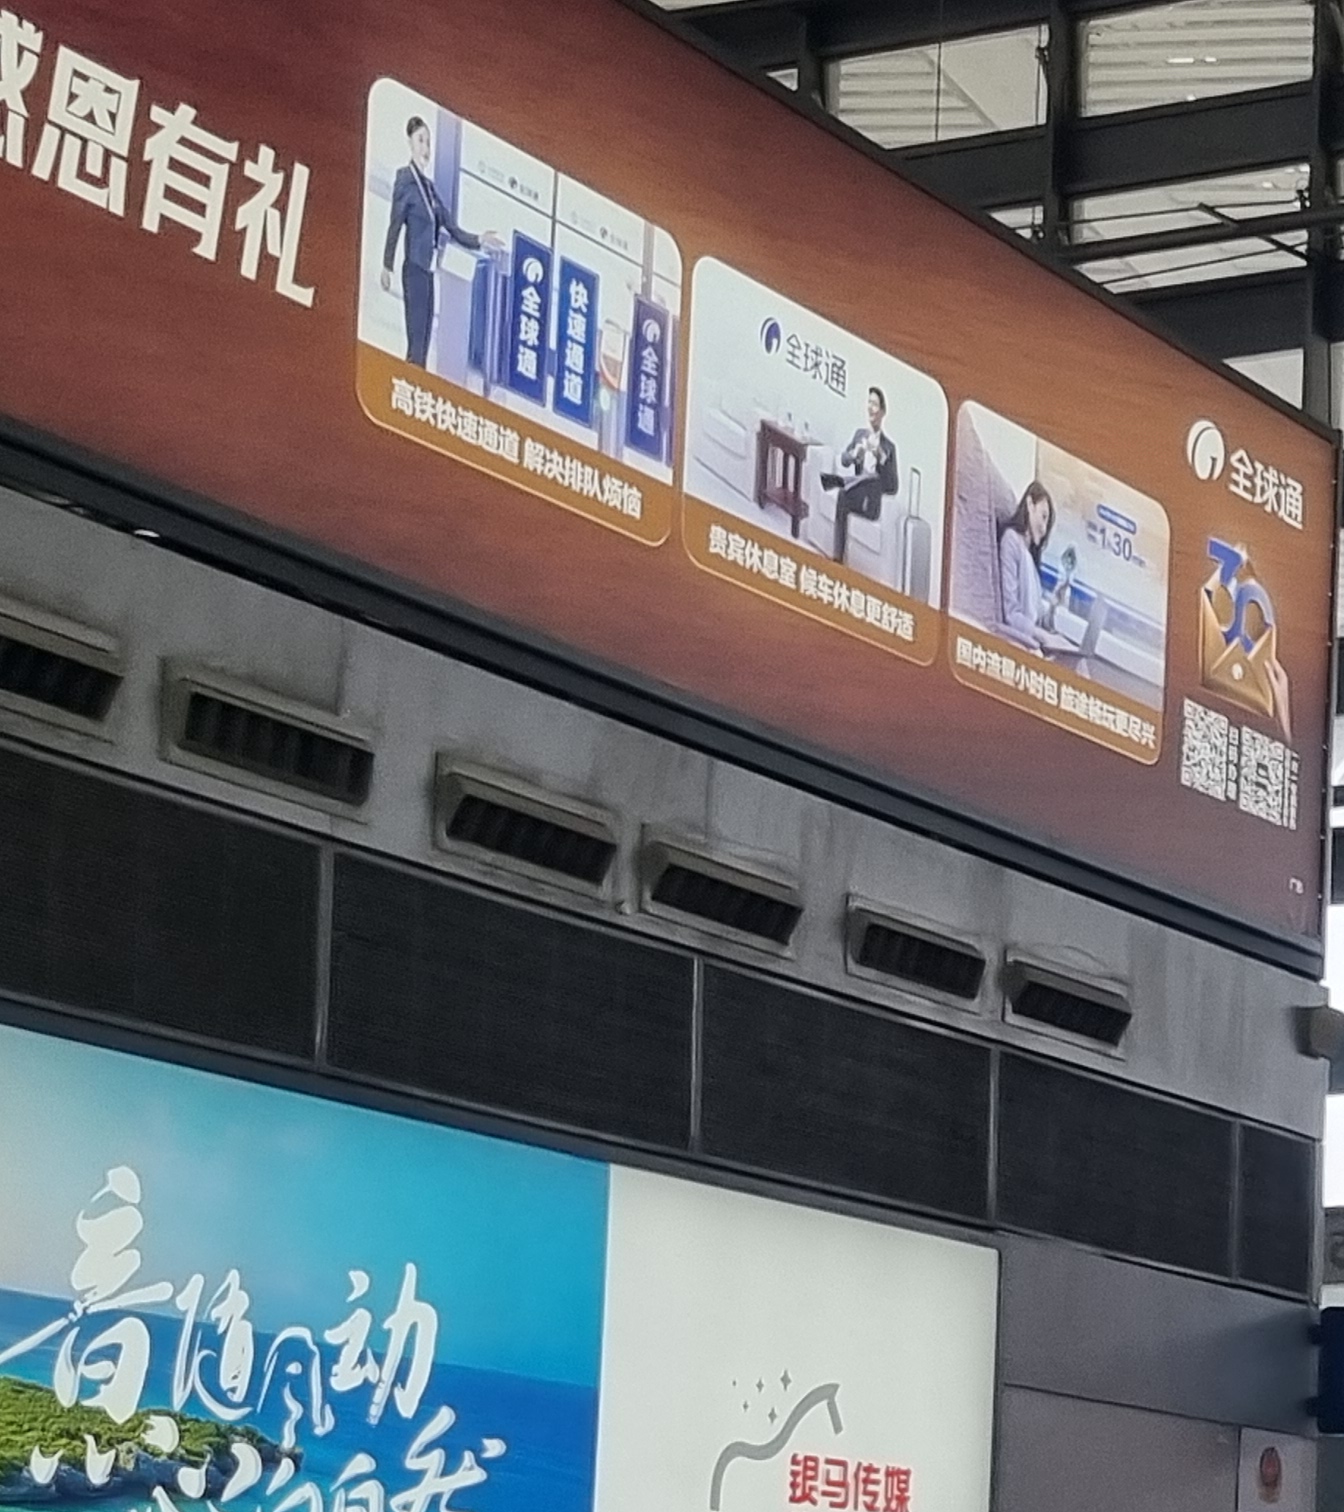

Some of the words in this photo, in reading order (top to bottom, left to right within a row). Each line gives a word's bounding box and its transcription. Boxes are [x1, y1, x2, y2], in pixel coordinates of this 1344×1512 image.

[517, 286, 542, 381] 全球通
[560, 278, 591, 405] 快速通道
[785, 334, 847, 398] 全球通
[637, 346, 661, 437] 全球通
[390, 377, 521, 465] 高铁快速通道
[522, 437, 643, 520] 解决排队烦恼
[1228, 448, 1304, 530] 全球通
[708, 523, 797, 590] 贵宾休息室
[799, 564, 915, 642] 候车休息更舒适
